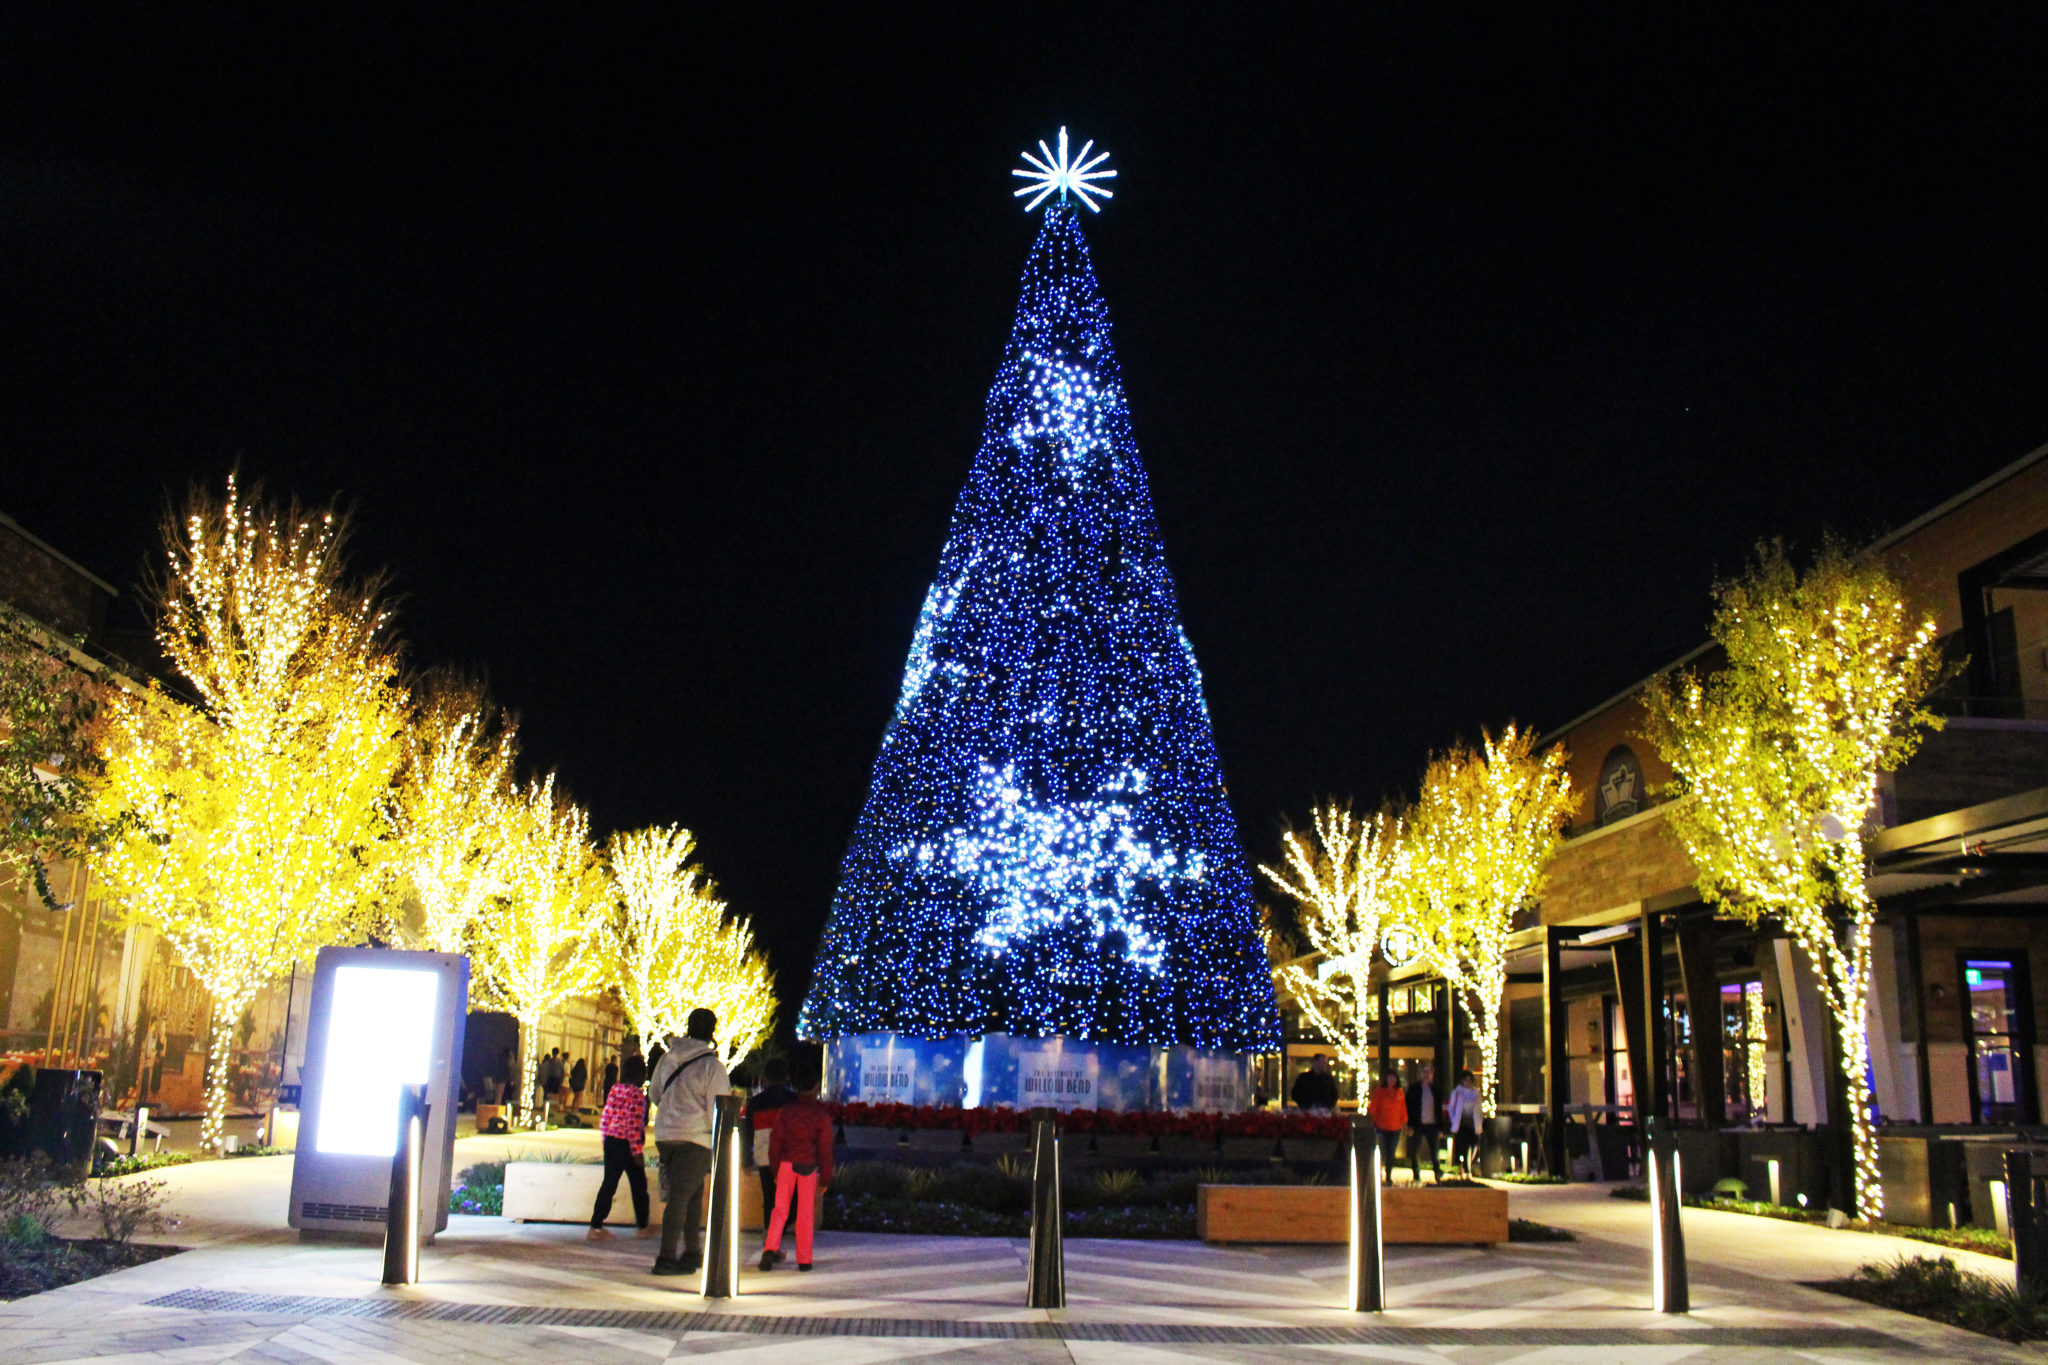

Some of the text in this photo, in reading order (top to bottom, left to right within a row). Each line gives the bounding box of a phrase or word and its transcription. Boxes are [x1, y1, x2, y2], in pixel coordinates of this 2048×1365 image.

[890, 1073, 909, 1089] BEND
[1025, 1077, 1091, 1094] WILLOW BEND
